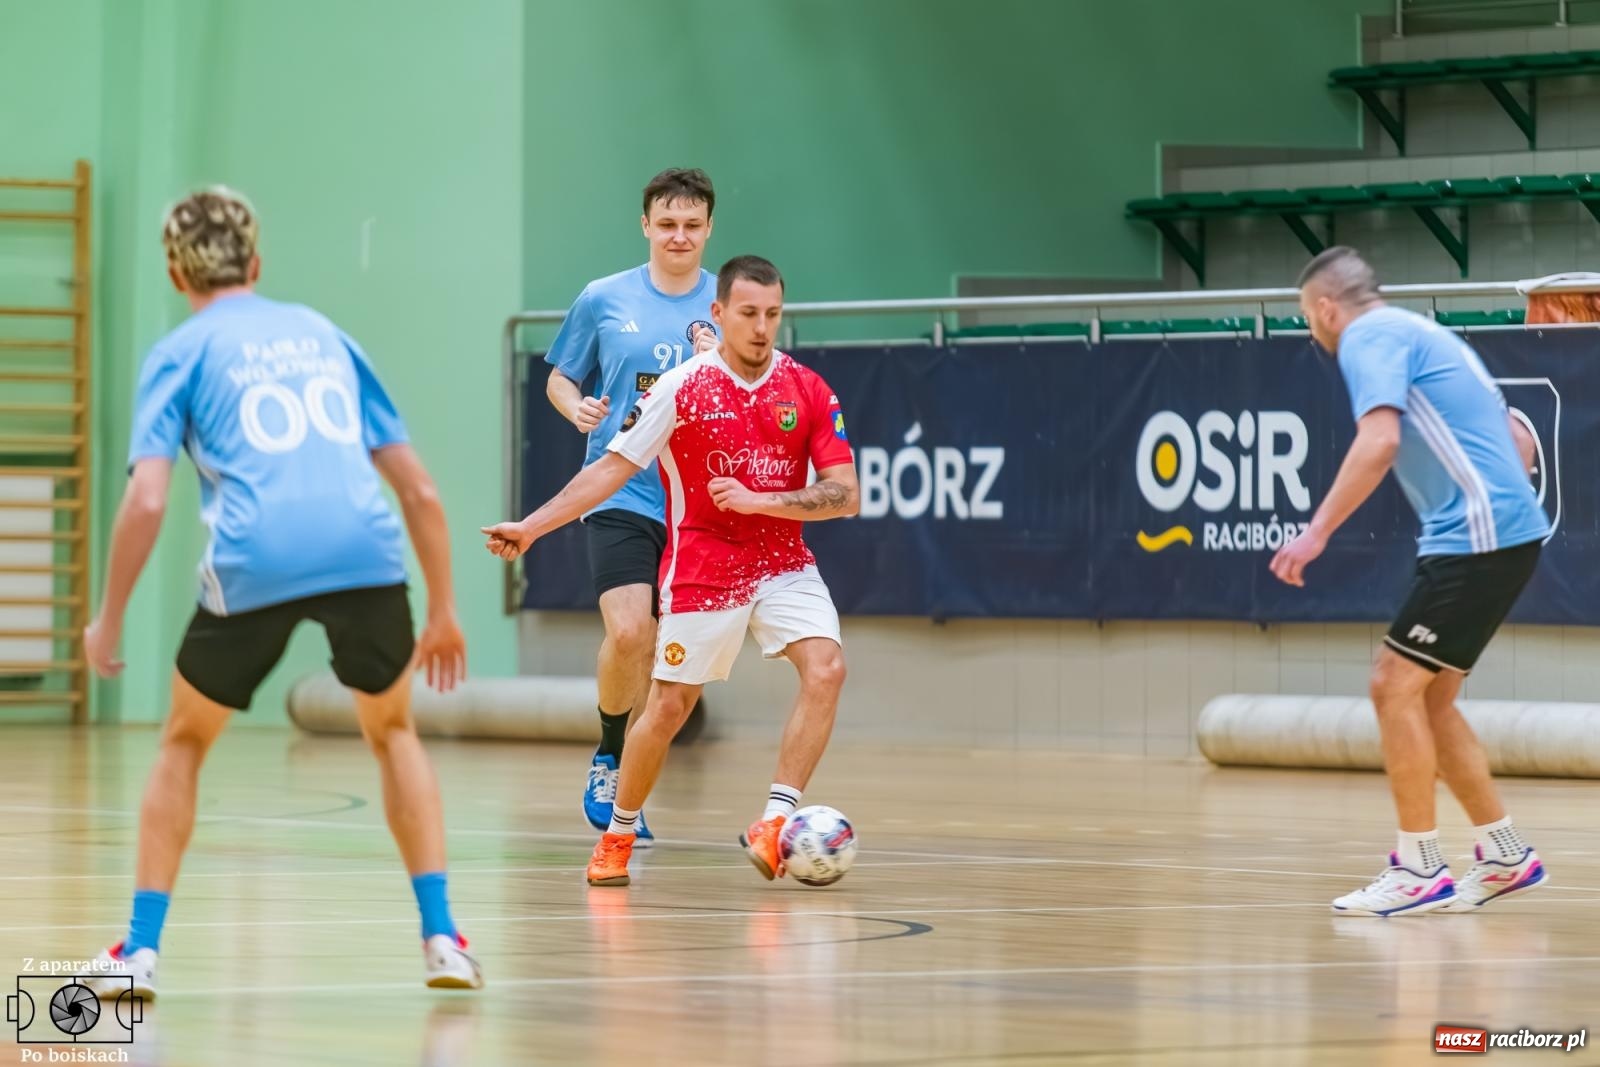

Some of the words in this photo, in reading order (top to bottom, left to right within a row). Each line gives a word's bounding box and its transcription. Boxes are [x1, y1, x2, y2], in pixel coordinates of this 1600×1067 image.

[654, 342, 683, 370] 91
[240, 375, 361, 455] 00
[849, 421, 1005, 519] BÓRZ
